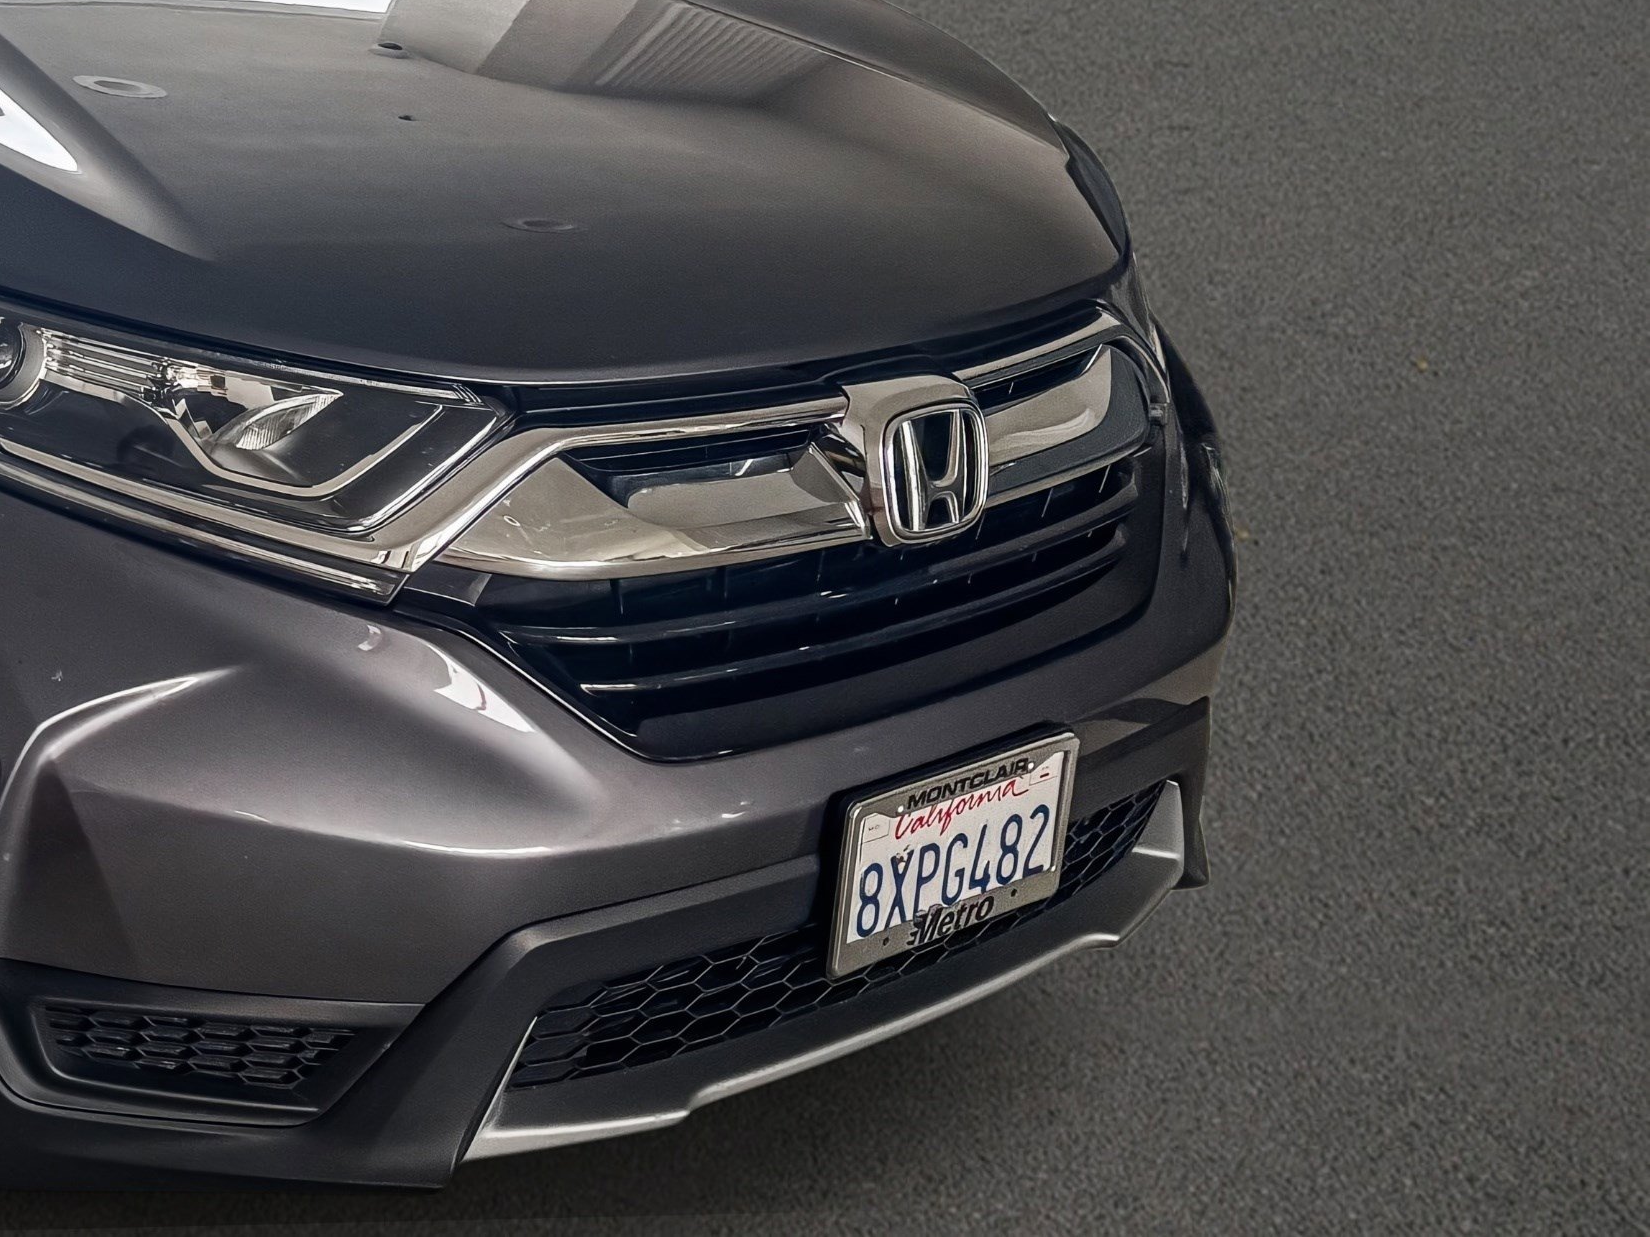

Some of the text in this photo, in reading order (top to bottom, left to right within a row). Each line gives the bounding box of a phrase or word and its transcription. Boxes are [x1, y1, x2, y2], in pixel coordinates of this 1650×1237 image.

[894, 777, 1031, 840] California
[906, 757, 1030, 810] MONTCLAIR
[855, 803, 1051, 938] 8XPG482
[906, 895, 995, 946] Metro
